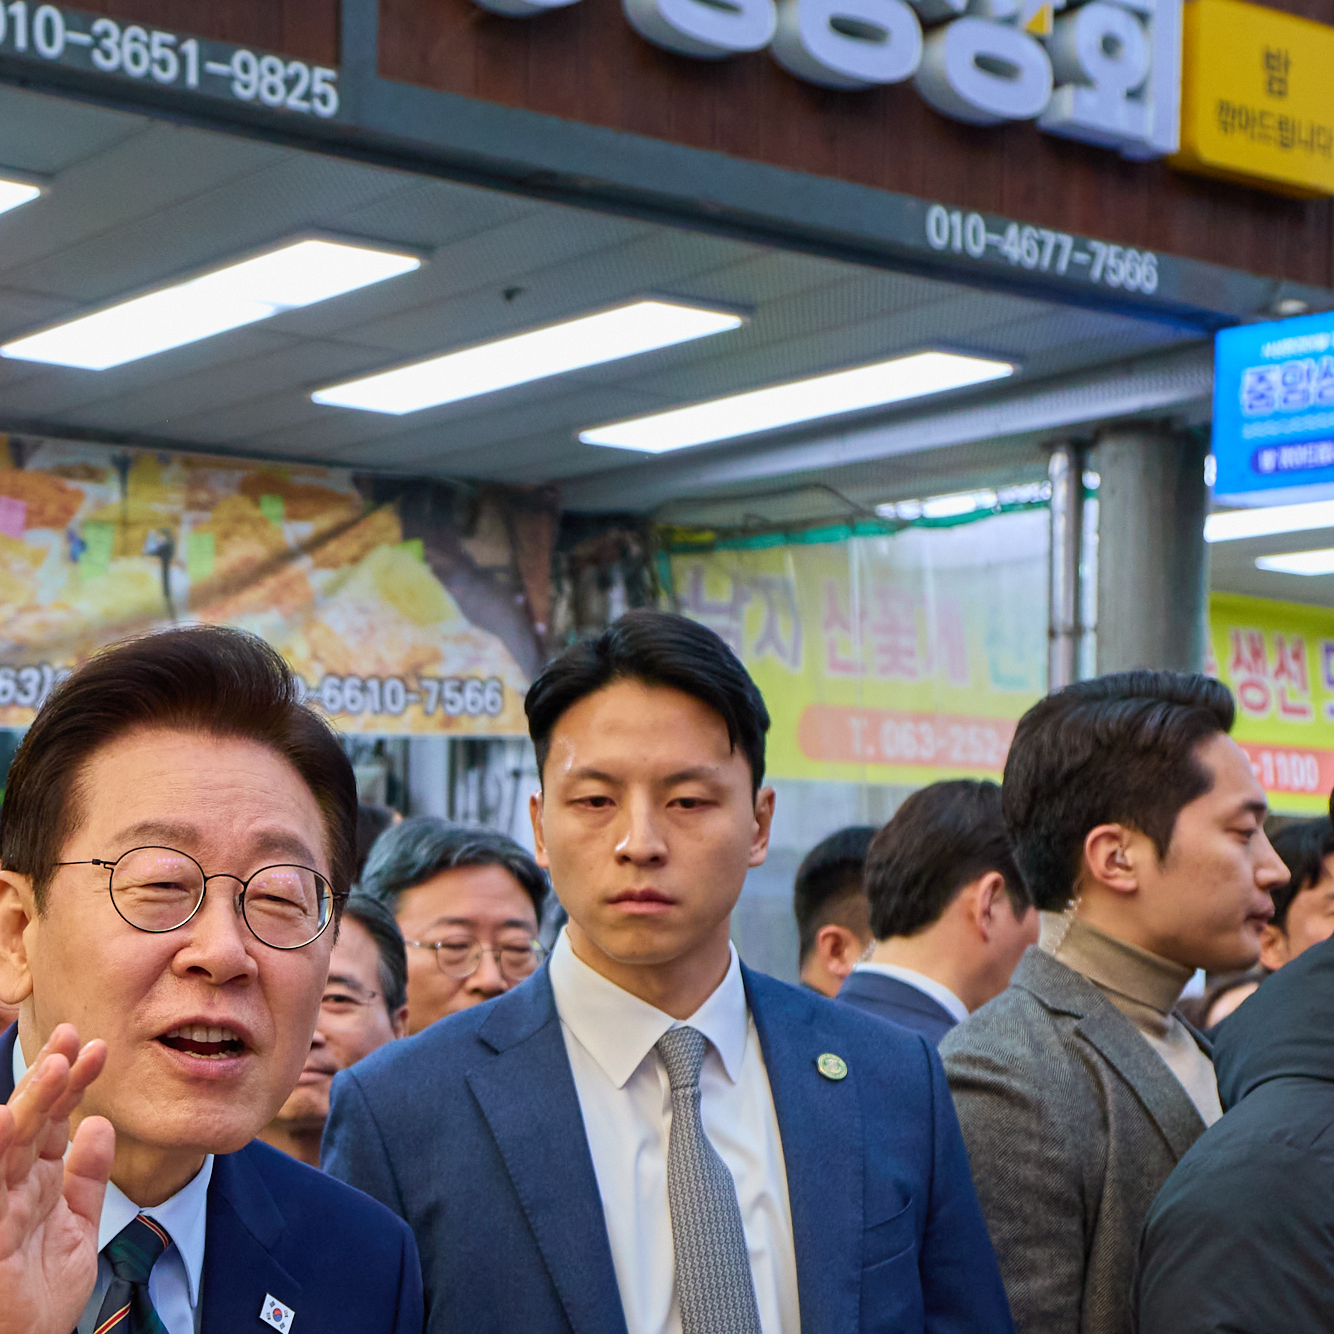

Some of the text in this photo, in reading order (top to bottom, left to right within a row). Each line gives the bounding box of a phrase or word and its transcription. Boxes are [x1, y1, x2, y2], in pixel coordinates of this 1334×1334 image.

[1263, 47, 1291, 98] 밤
[925, 205, 1159, 295] 010-4677-7566
[1230, 628, 1312, 718] 생선
